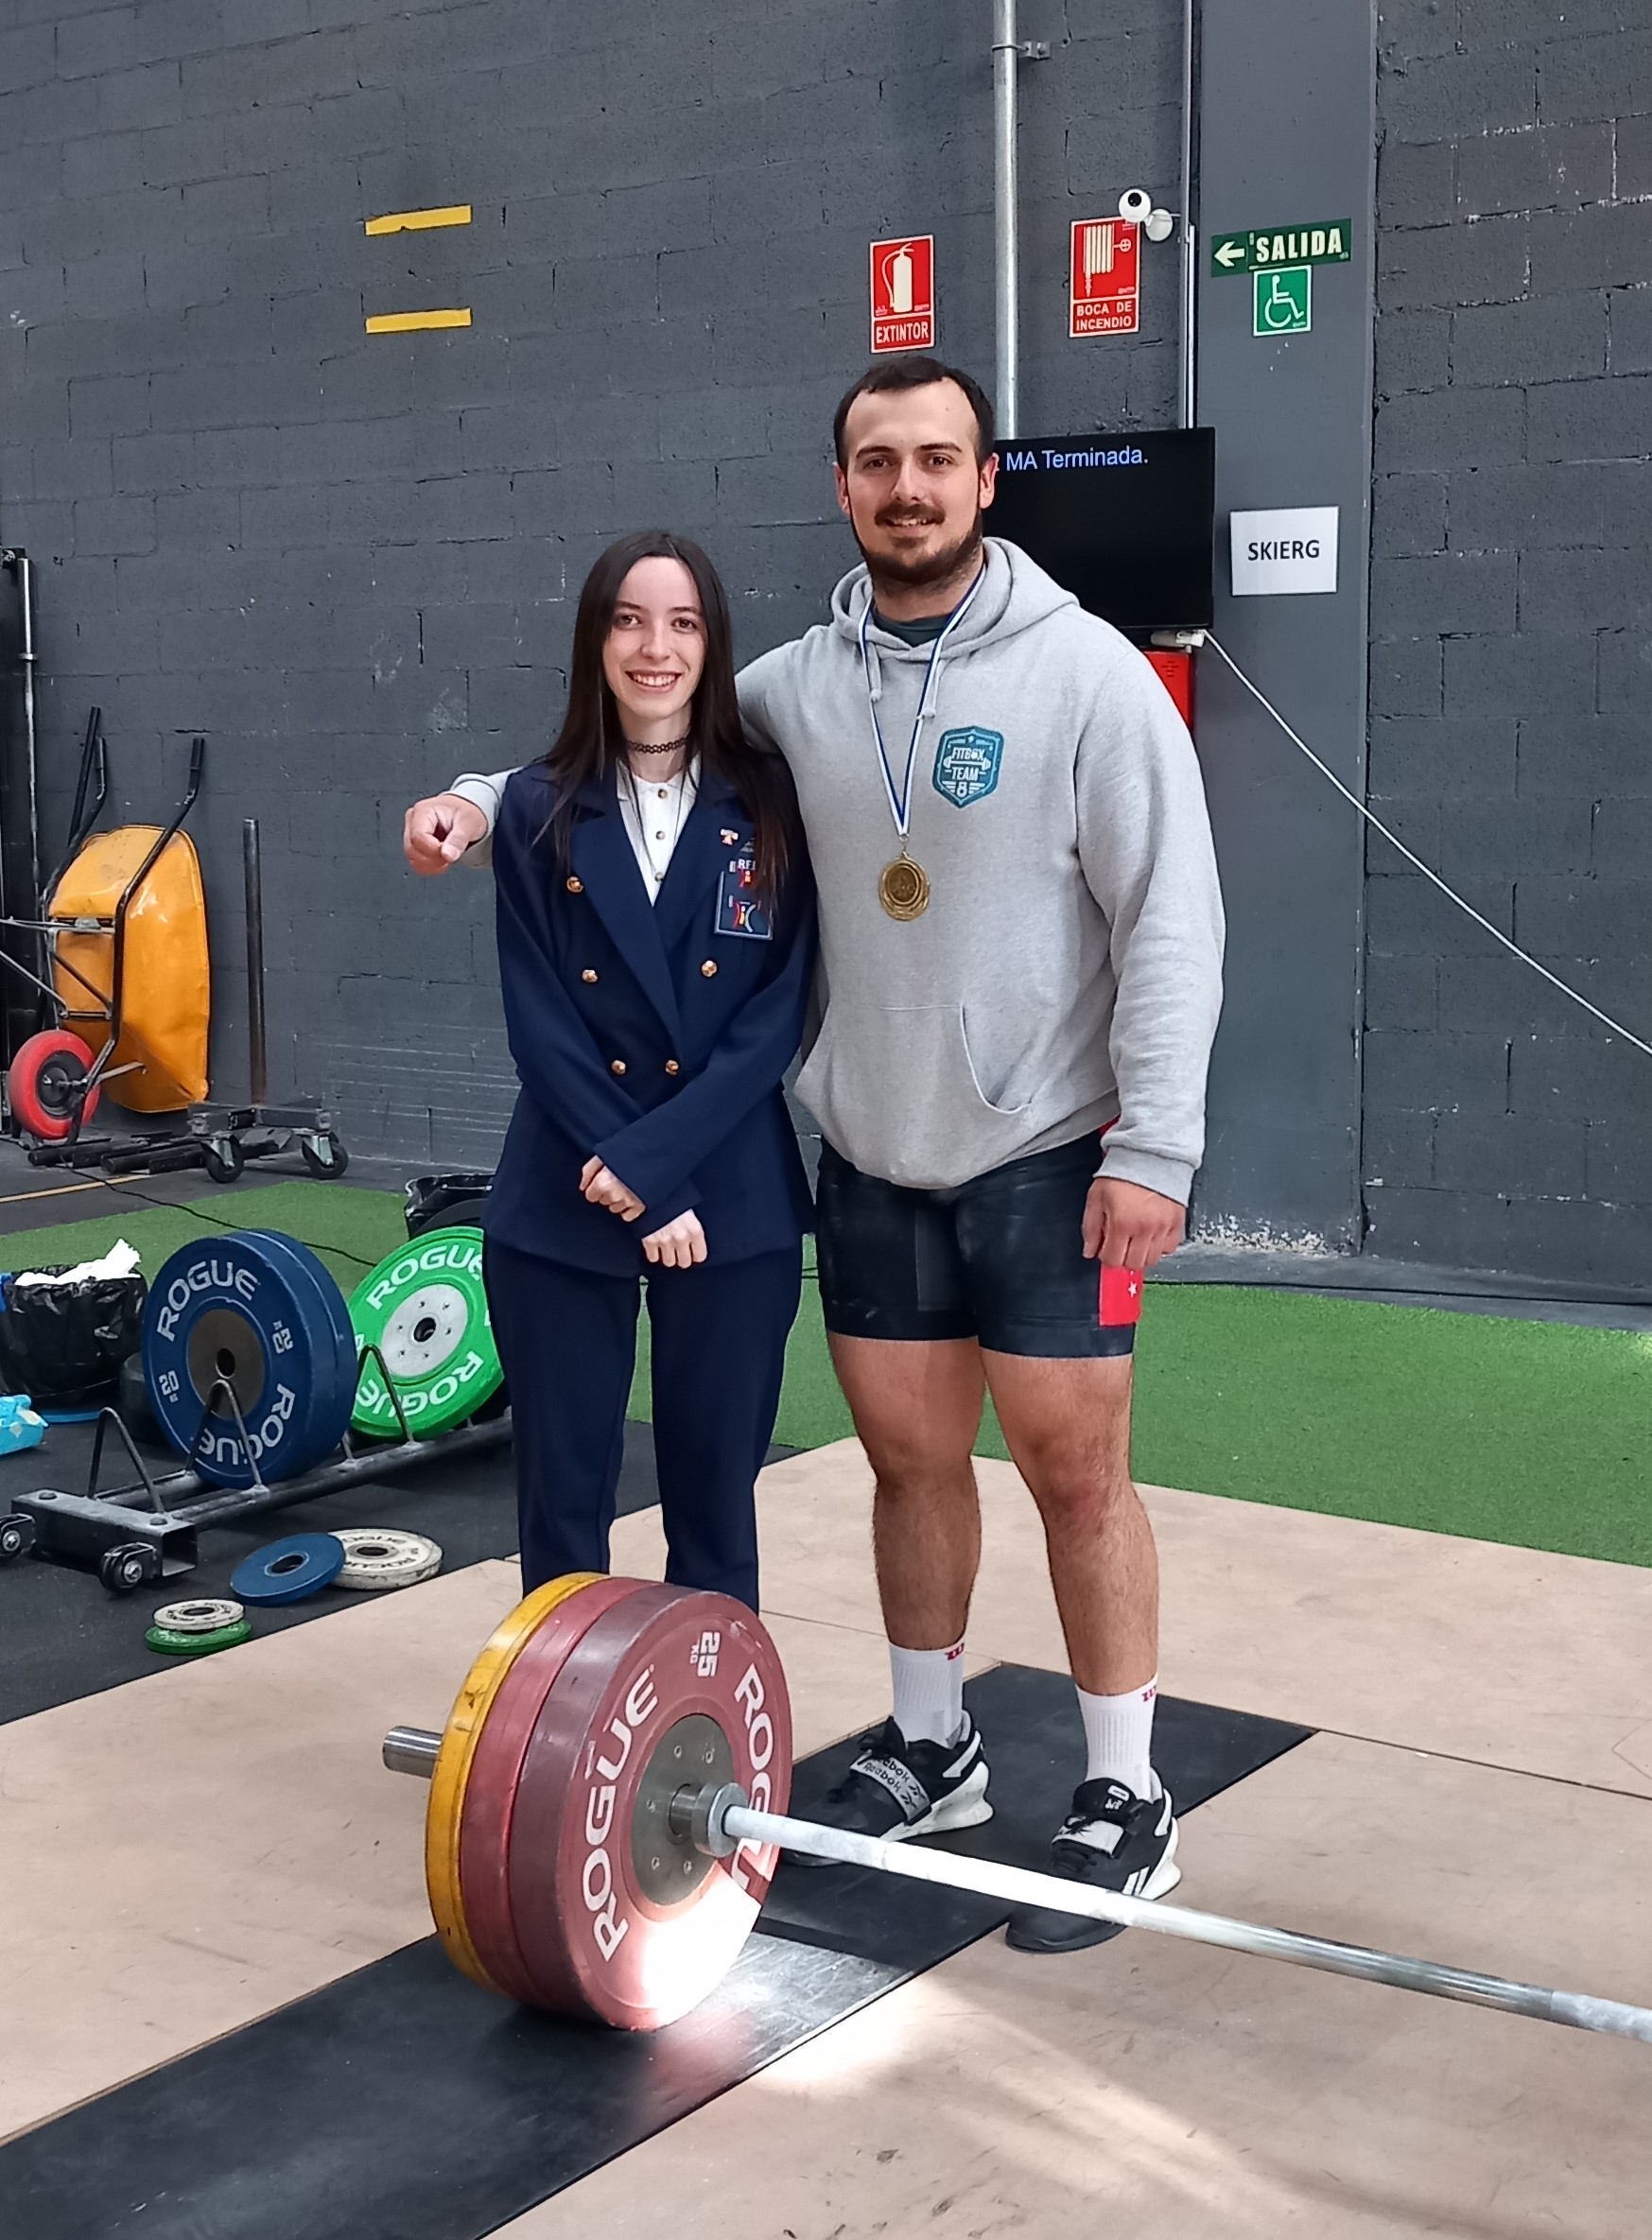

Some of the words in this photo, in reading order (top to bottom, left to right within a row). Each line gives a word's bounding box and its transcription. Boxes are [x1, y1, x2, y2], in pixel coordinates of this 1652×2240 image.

[1256, 227, 1343, 263] SALIDA
[1076, 303, 1110, 317] BOCA
[1116, 301, 1133, 313] DE
[876, 321, 930, 344] EXTINTOR
[1075, 315, 1133, 331] INCENDIO
[1006, 450, 1038, 471] MA
[1041, 444, 1149, 469] Terminada.
[1247, 539, 1320, 562] SKIERG
[951, 766, 980, 782] TEAM
[156, 1259, 260, 1343] ROGUE
[271, 1327, 294, 1355] 20
[158, 1370, 180, 1397] 20
[356, 1350, 484, 1417] ROGUE
[697, 1631, 721, 1677] 25
[582, 1662, 659, 1963] ROGUE
